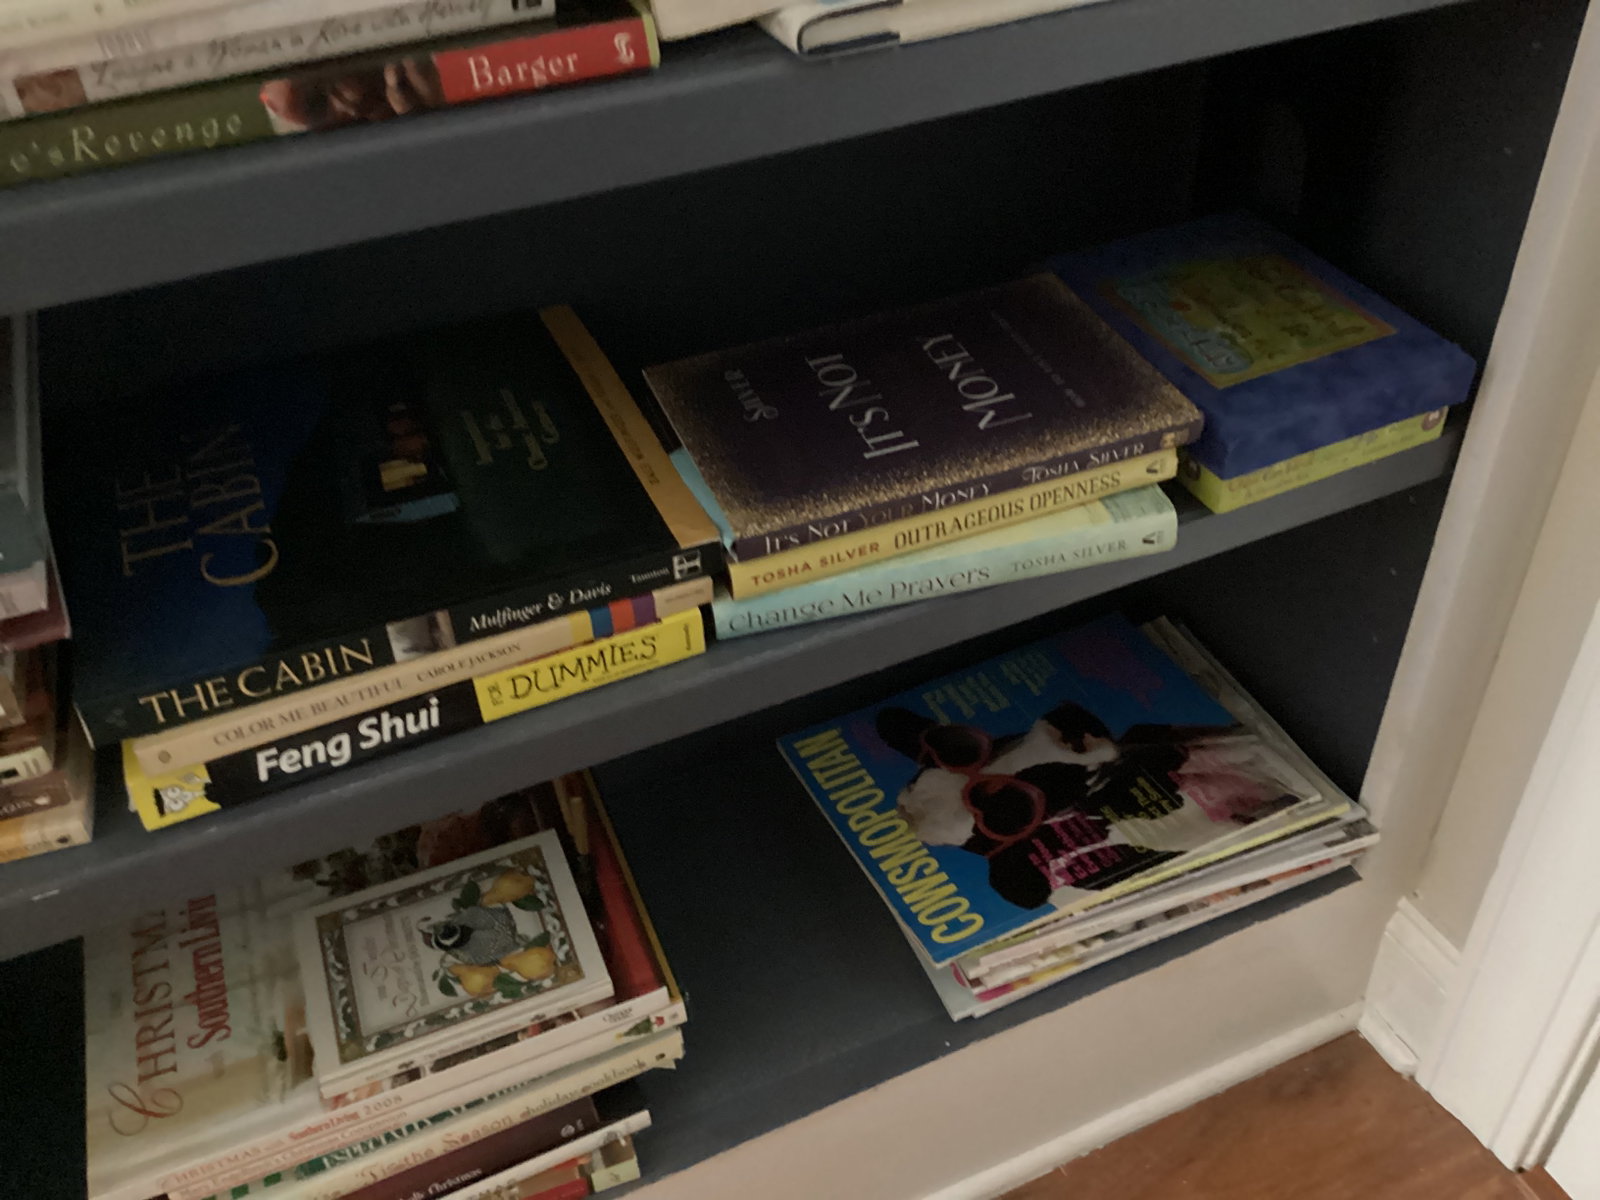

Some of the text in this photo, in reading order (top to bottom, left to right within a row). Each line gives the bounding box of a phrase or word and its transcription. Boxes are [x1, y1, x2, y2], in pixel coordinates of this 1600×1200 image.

[467, 51, 579, 92] Barger
[72, 112, 243, 162] Revenge
[115, 471, 194, 577] THE
[188, 422, 280, 587] CABIN
[750, 471, 1123, 587] TOSHA SILVER OUTRAGEOUS OPENNESS
[468, 601, 544, 634] Mulfinger
[546, 592, 564, 611] &
[569, 581, 613, 605] Davis
[841, 585, 884, 609] Me
[889, 564, 992, 602] Prayers
[1012, 553, 1068, 574] TOSHA
[1070, 537, 1127, 561] SILVER
[138, 637, 375, 724] THE CABIN
[255, 731, 353, 784] Feng
[356, 693, 441, 751] Shui
[509, 633, 658, 700] DUMMIES
[212, 716, 277, 748] COLOR
[792, 726, 986, 945] COWSMOPOLITAN
[187, 940, 232, 1049] Southern
[441, 1113, 514, 1153] Season
[427, 1167, 483, 1195] Christmas
